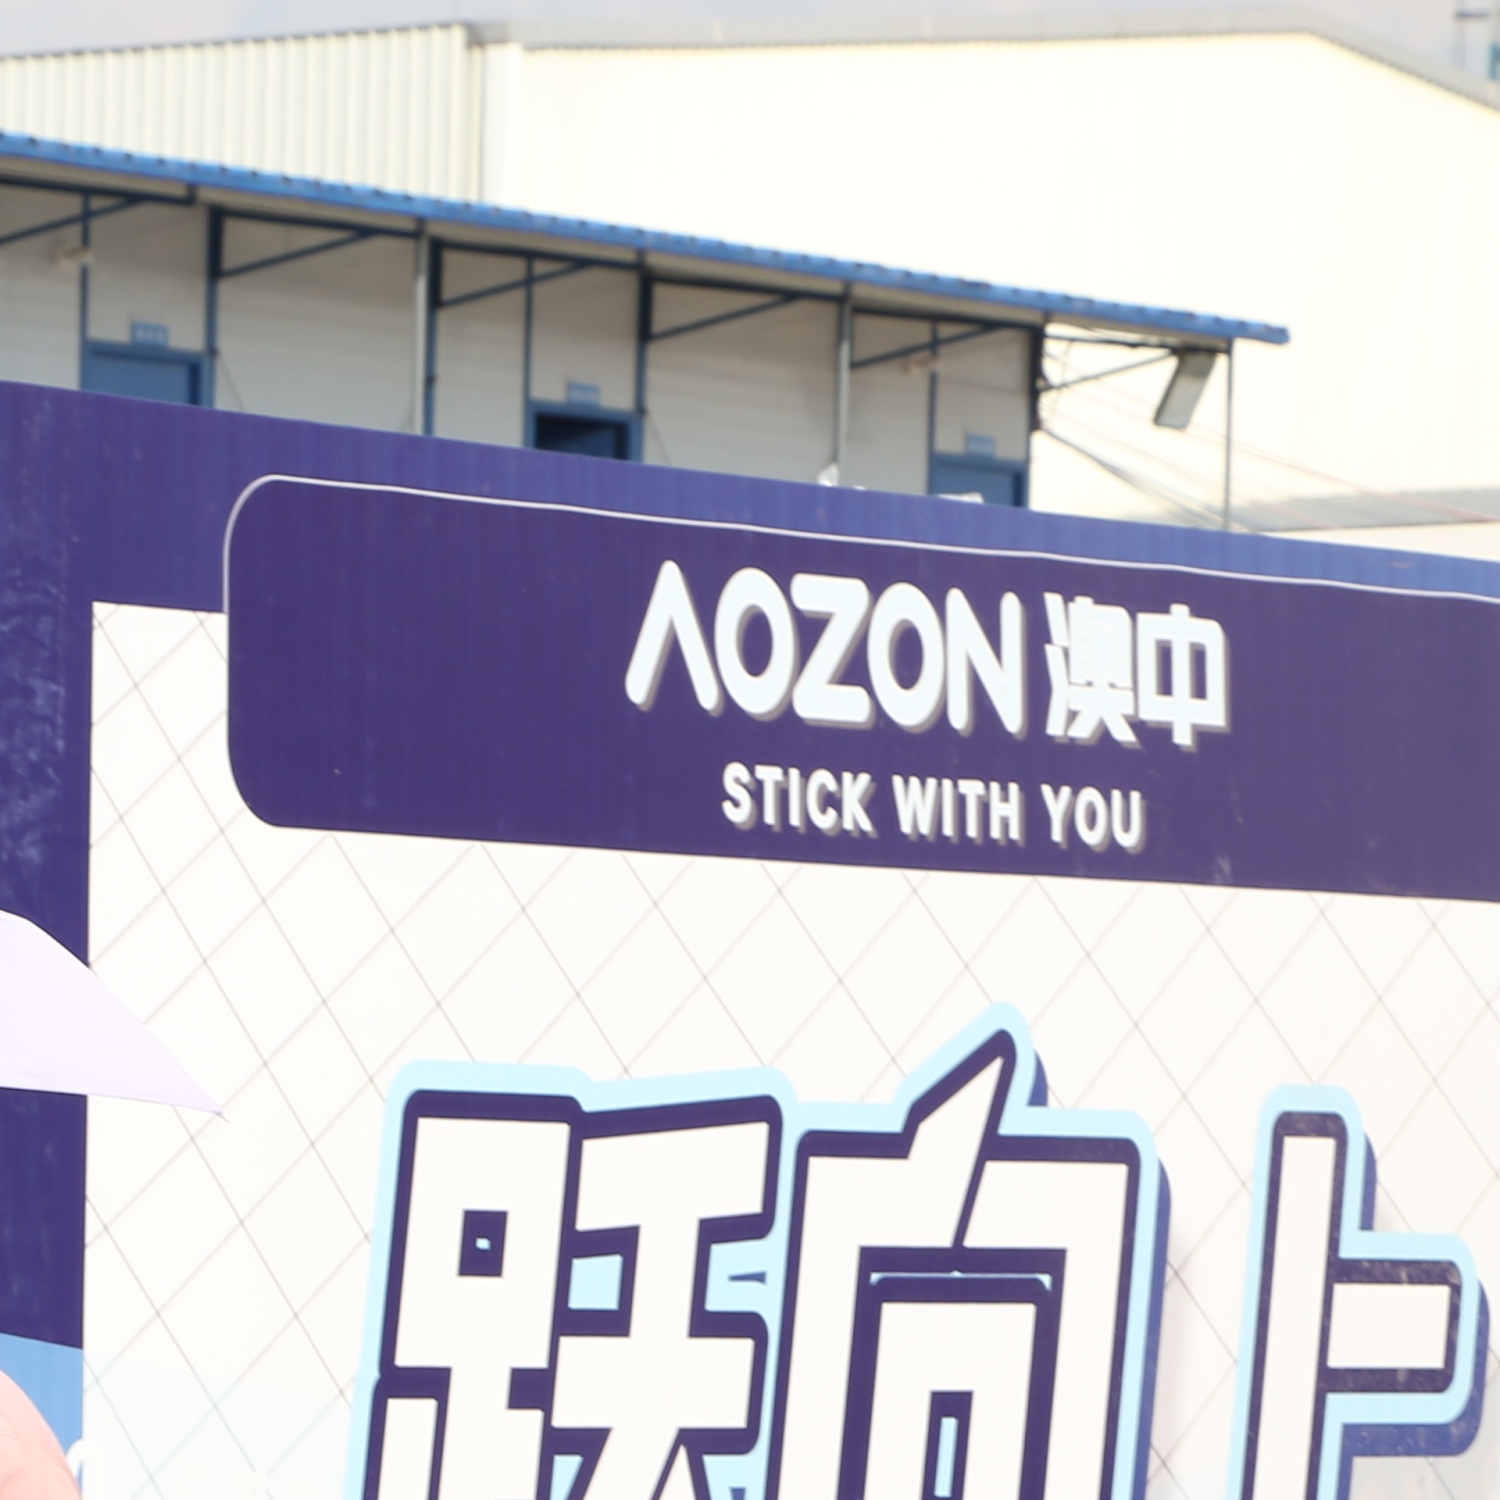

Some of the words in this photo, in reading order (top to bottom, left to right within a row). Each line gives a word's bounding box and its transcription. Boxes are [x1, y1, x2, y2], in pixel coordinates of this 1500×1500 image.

[625, 559, 1023, 736] AOZON
[1044, 591, 1230, 749] 澳中
[722, 761, 876, 835] STICK
[892, 773, 1023, 844] WITH
[1040, 784, 1146, 852] YOU
